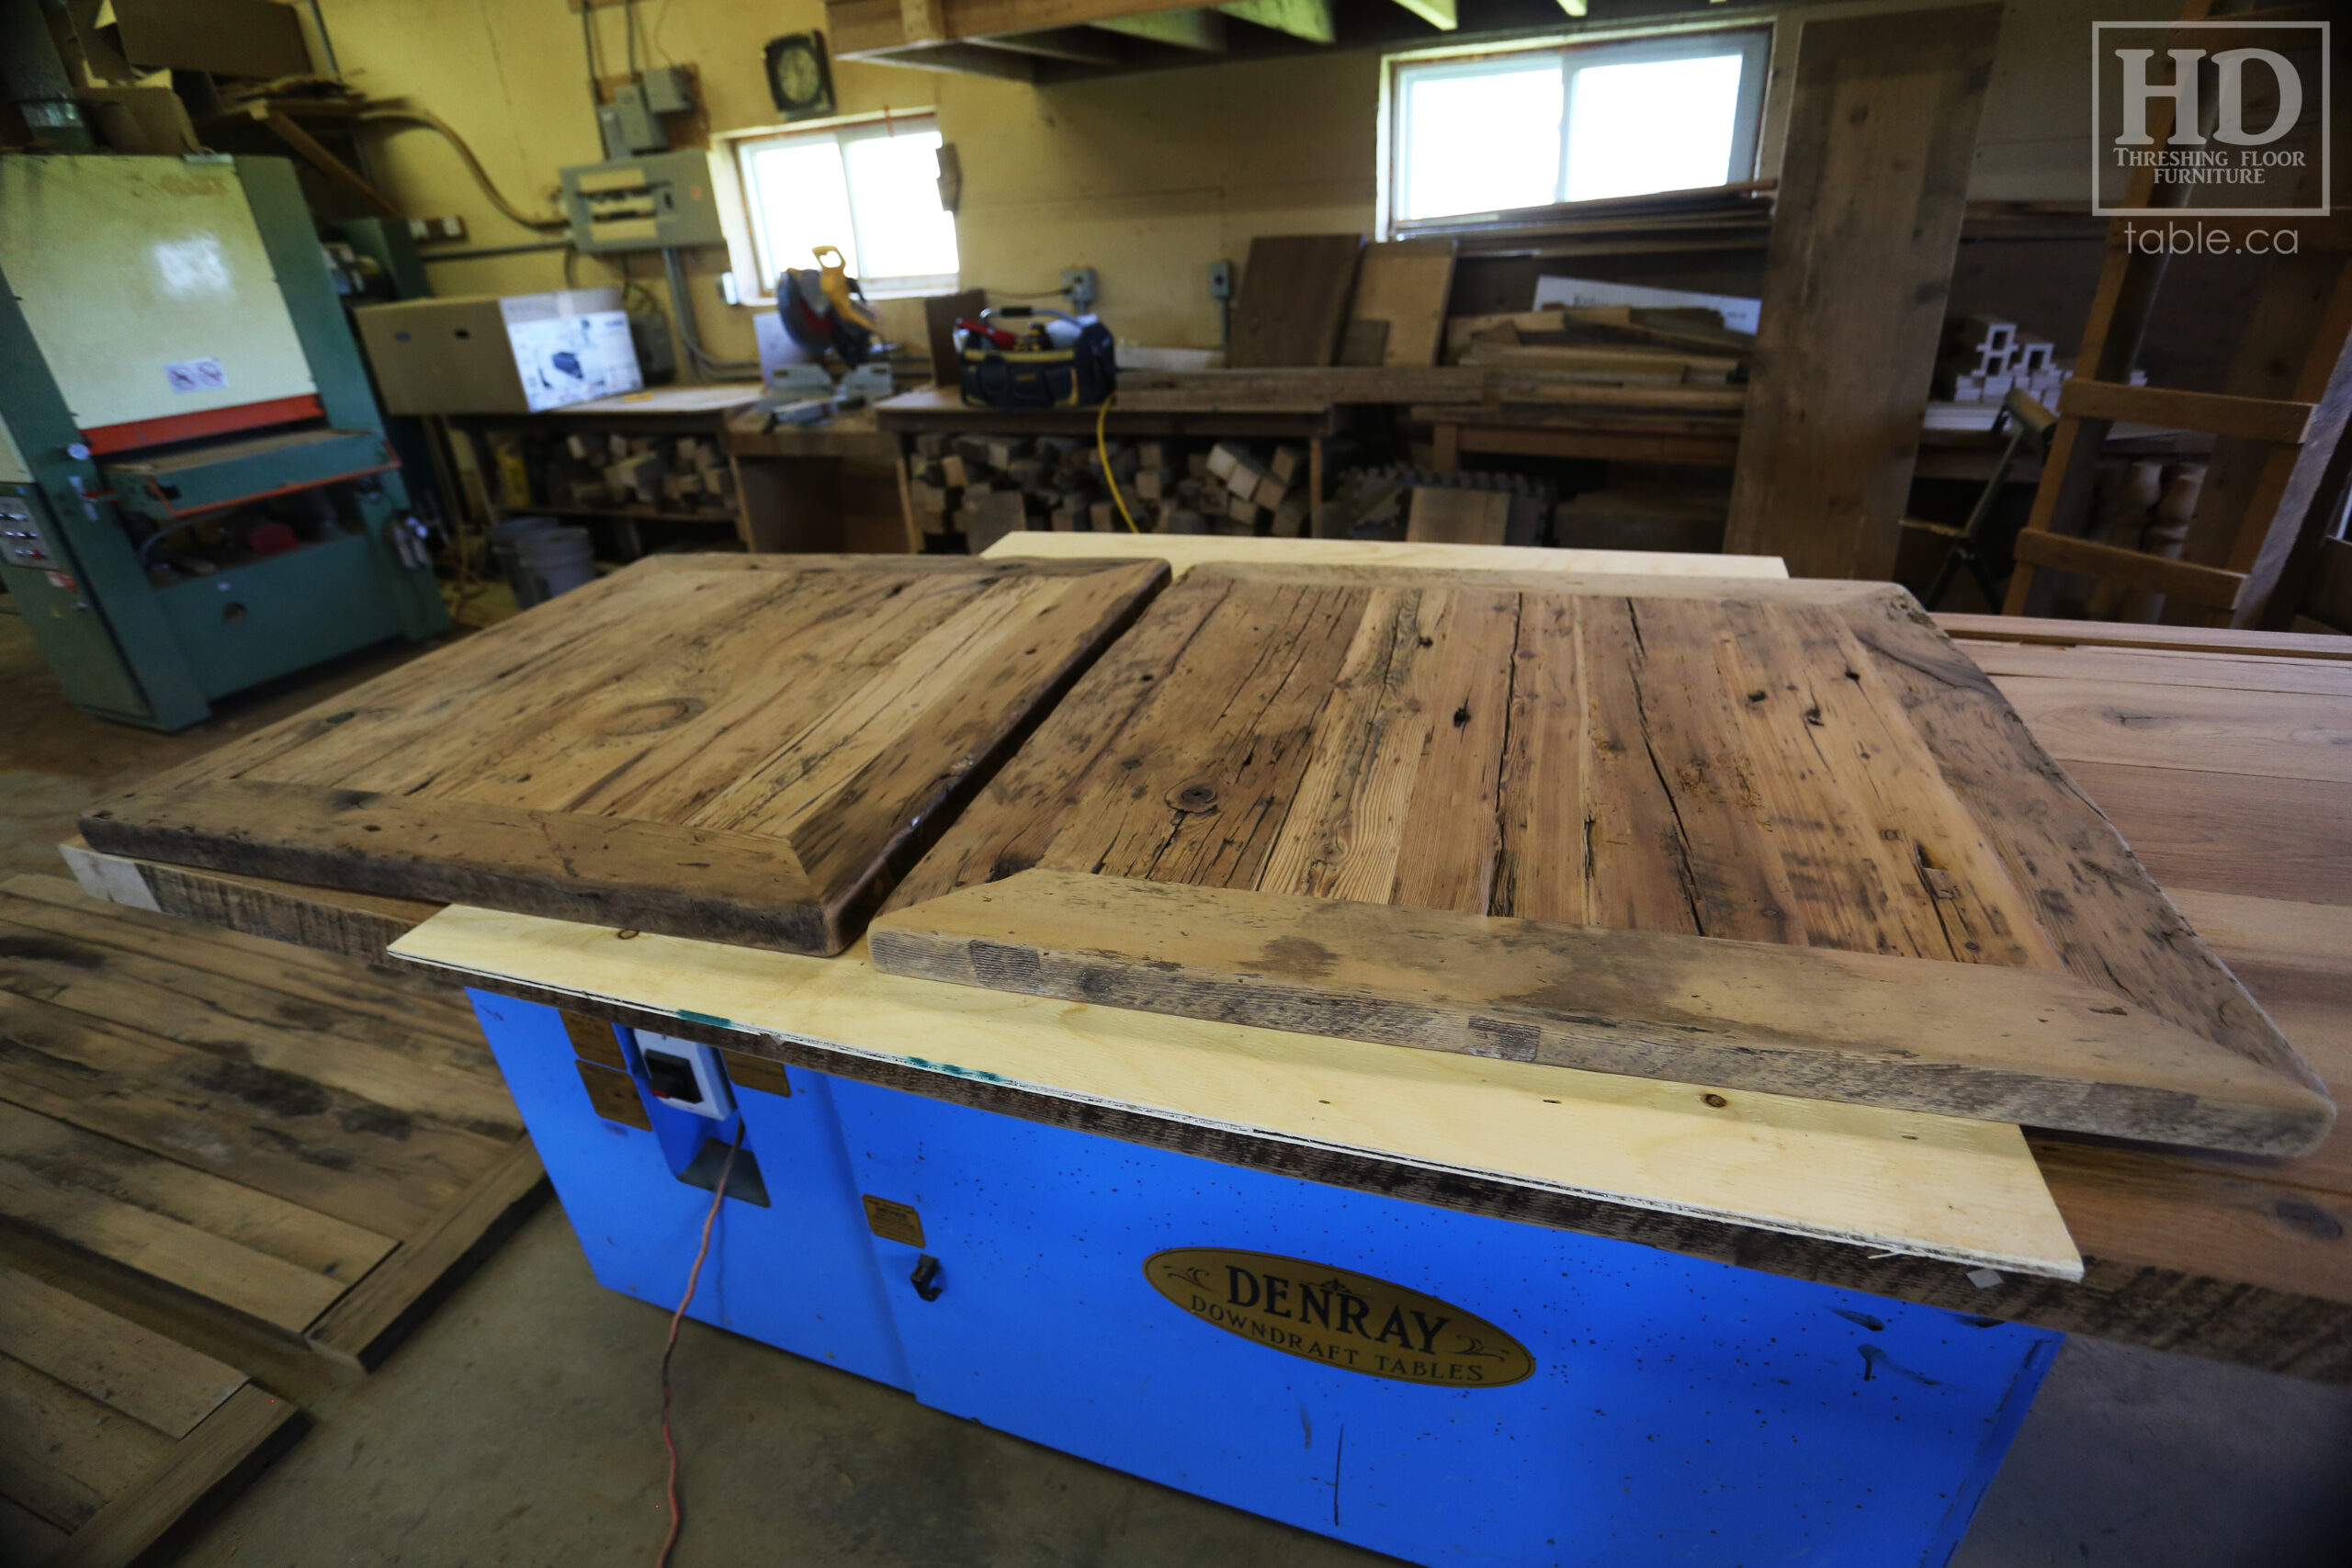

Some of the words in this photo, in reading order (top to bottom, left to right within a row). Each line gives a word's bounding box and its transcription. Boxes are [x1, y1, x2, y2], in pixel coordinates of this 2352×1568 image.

[1191, 1294, 1360, 1365] DOWNDRAFT
[1375, 1353, 1485, 1382] TABLES
[1225, 1264, 1451, 1355] DENRAY
